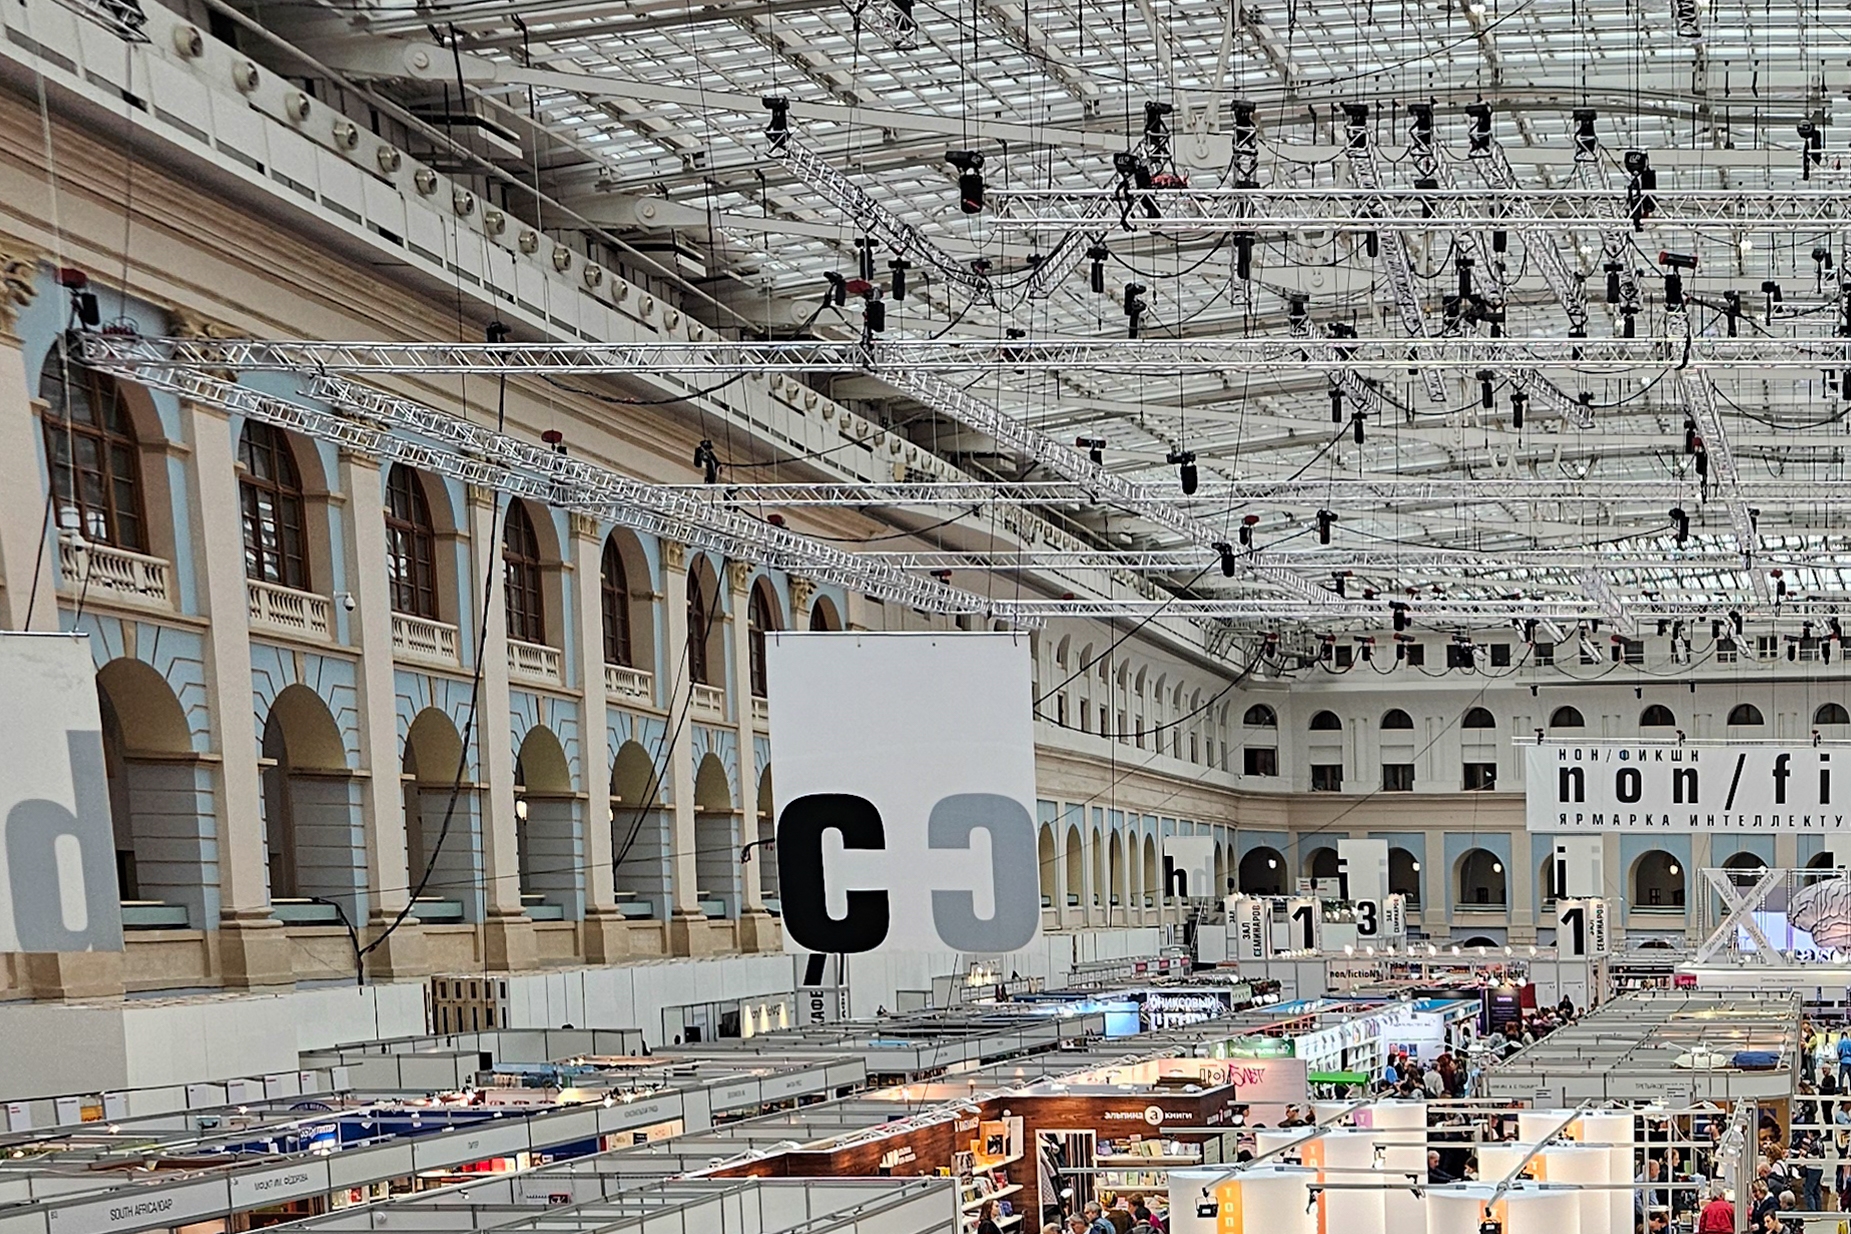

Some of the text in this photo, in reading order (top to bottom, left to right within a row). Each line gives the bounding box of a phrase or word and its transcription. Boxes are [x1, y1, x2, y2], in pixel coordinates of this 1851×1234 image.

[1559, 749, 1699, 763] НОН/ФИКШН
[1559, 815, 1670, 827] ЯРМАРКА
[1357, 900, 1377, 936] 3
[1242, 922, 1251, 940] ЗАЛ
[1252, 904, 1262, 957] СЕМИНАРОВ
[1291, 905, 1315, 950] 1
[1560, 908, 1585, 956] 1
[1165, 1112, 1193, 1120] книги
[110, 1206, 133, 1222] SOUTH
